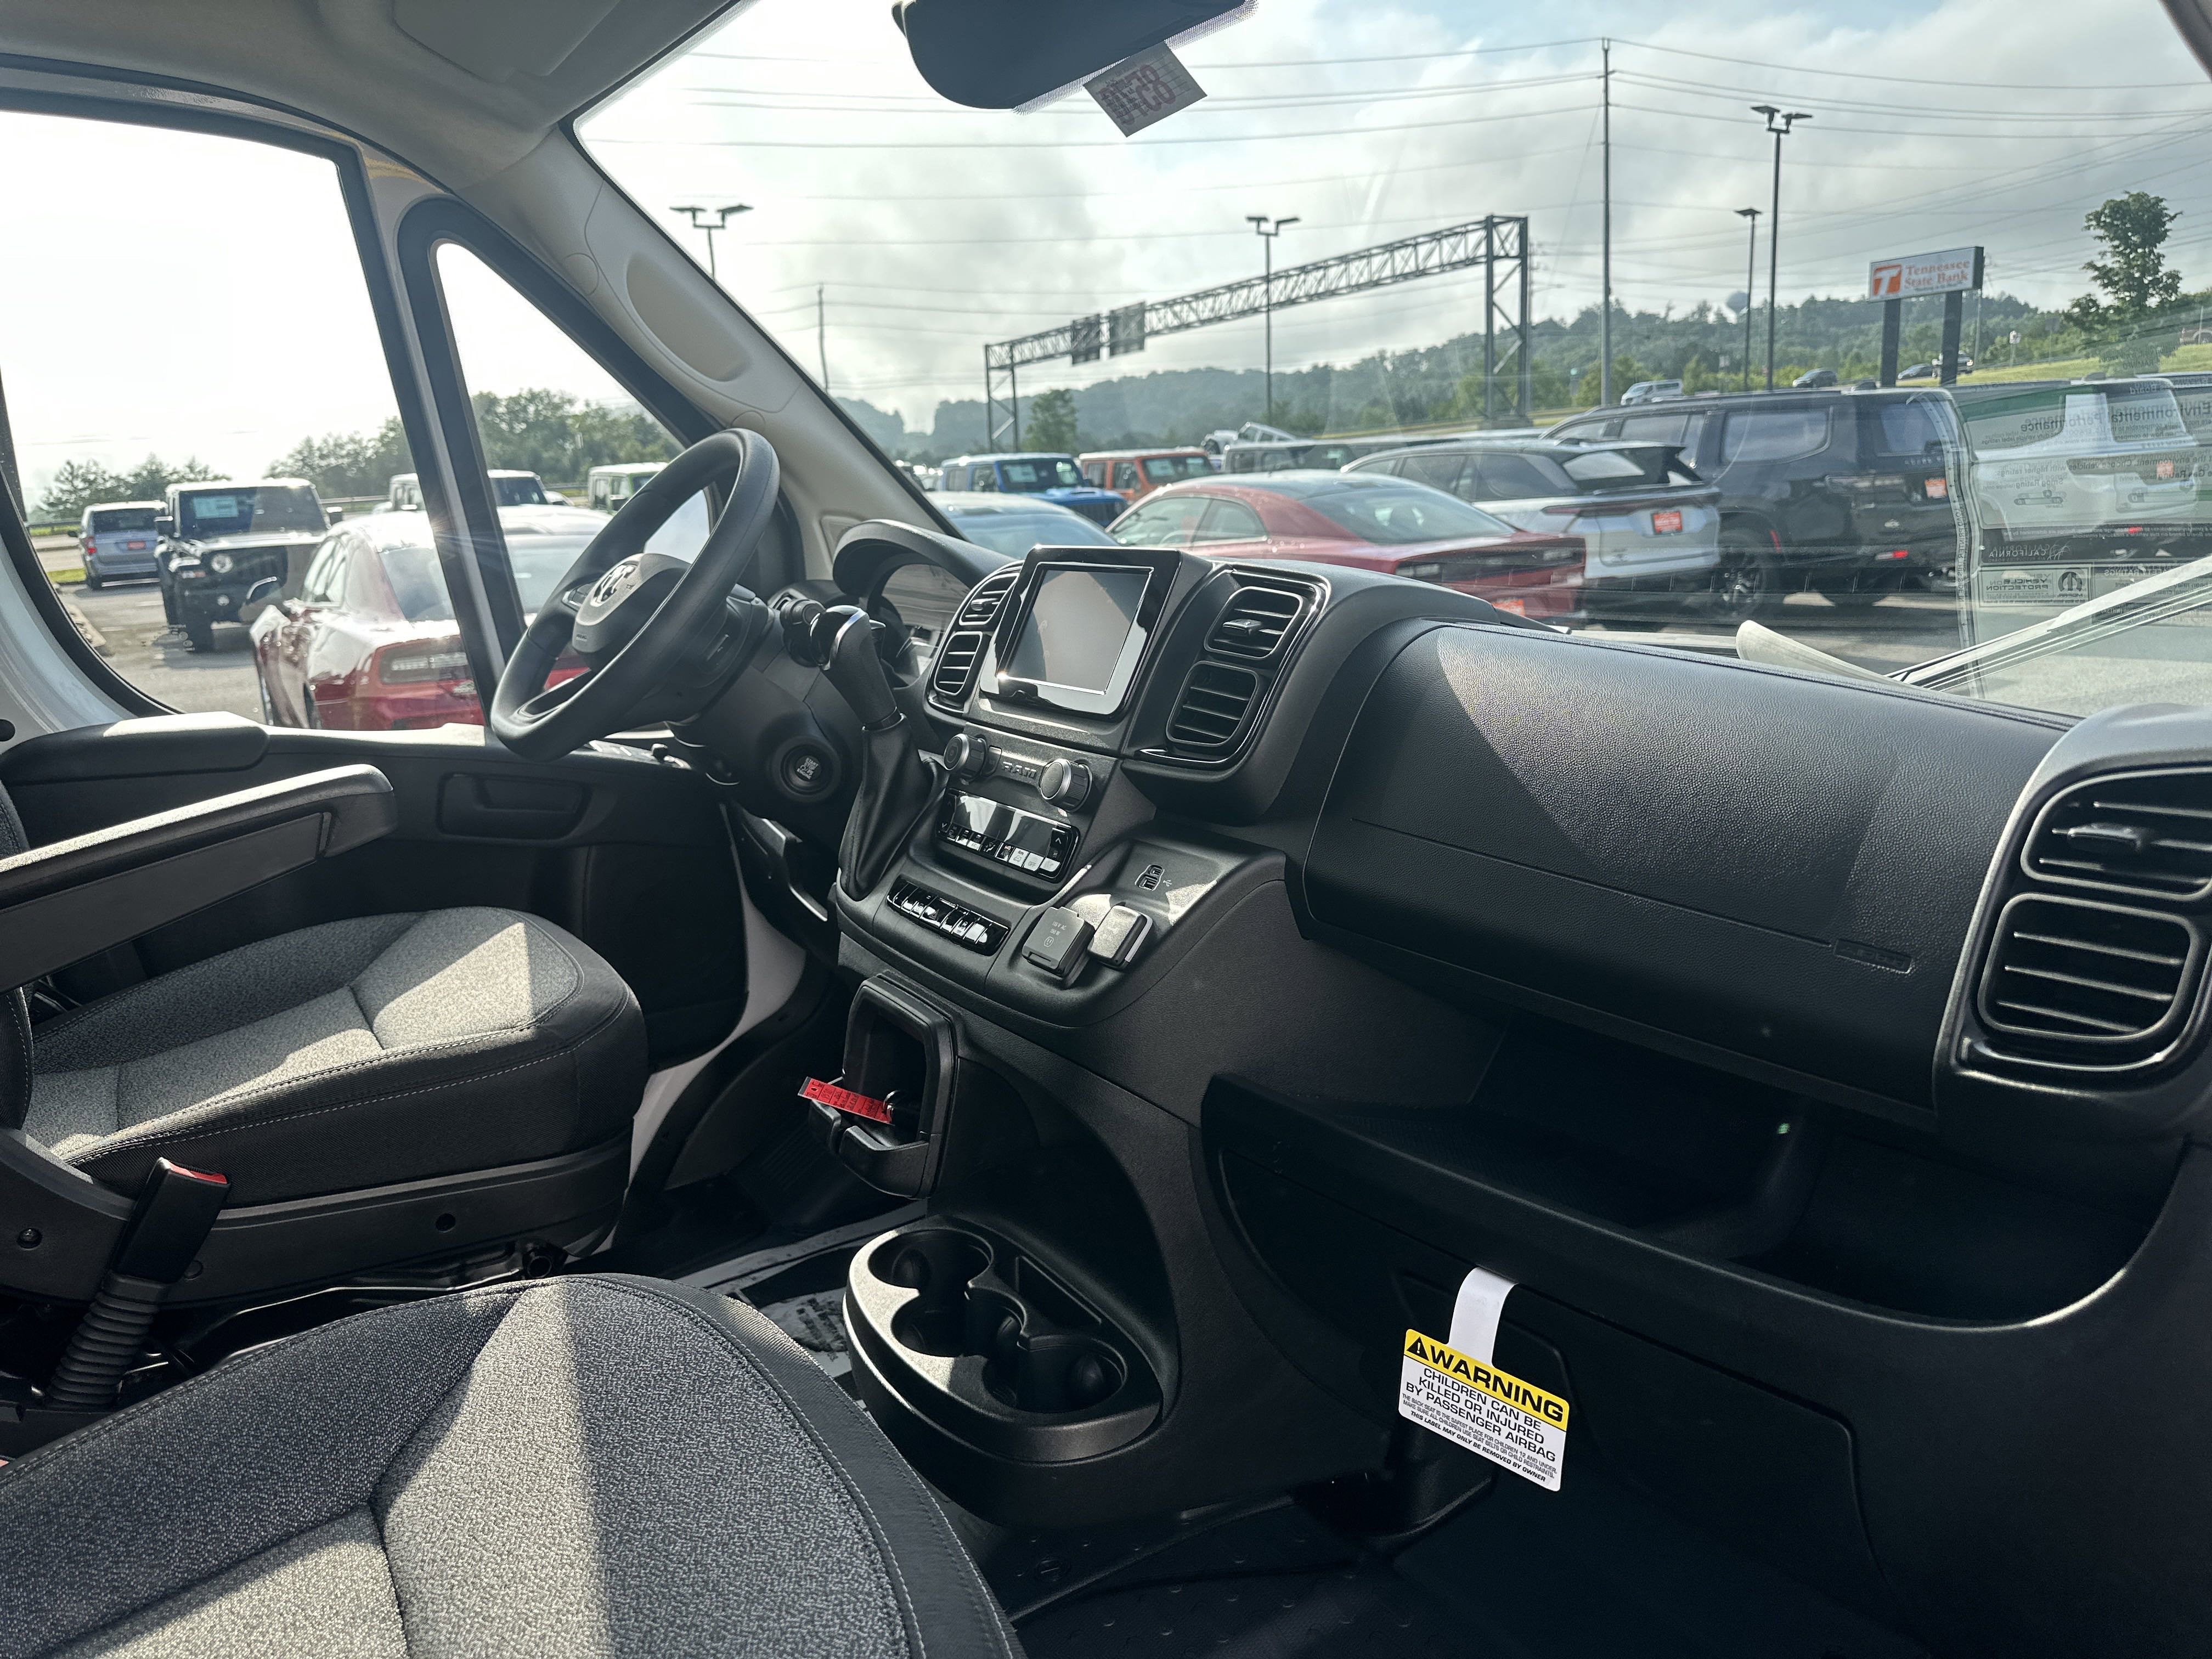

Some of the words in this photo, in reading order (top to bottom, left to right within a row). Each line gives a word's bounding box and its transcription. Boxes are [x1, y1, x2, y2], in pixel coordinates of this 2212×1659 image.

[1905, 259, 1970, 275] Tennessee
[1905, 276, 1933, 287] State
[1937, 271, 1968, 284] Bank
[1418, 1376, 1460, 1404] KILLED
[1464, 1398, 1482, 1415] OR
[1486, 1409, 1544, 1445] INJURED
[1423, 1367, 1487, 1406] CHILDREN
[1491, 1398, 1519, 1421] CAN
[1523, 1414, 1541, 1431] BE
[1429, 1344, 1564, 1424] WARNING
[1402, 1392, 1410, 1401] THE
[1411, 1397, 1423, 1408] BACK
[1424, 1403, 1435, 1413] SEAT
[1441, 1412, 1450, 1421] THE
[1451, 1417, 1468, 1430] SAFEST
[1468, 1425, 1483, 1437] PLACE
[1484, 1433, 1493, 1442] FOR
[1494, 1438, 1518, 1454] CHILDREN
[1519, 1450, 1526, 1458] 12
[1527, 1454, 1537, 1464] AND
[1406, 1381, 1423, 1397] BY
[1426, 1391, 1501, 1436] PASSENGER
[1505, 1429, 1556, 1463] AIRBAG
[1410, 1410, 1423, 1420] THIS
[1424, 1417, 1441, 1430] LABEL
[1442, 1426, 1455, 1437] MAY
[1456, 1432, 1472, 1446] ONLY
[1472, 1441, 1481, 1449] BE
[1482, 1446, 1511, 1465] REMOVED
[1513, 1461, 1521, 1470] BY
[1522, 1466, 1545, 1482] OWNER
